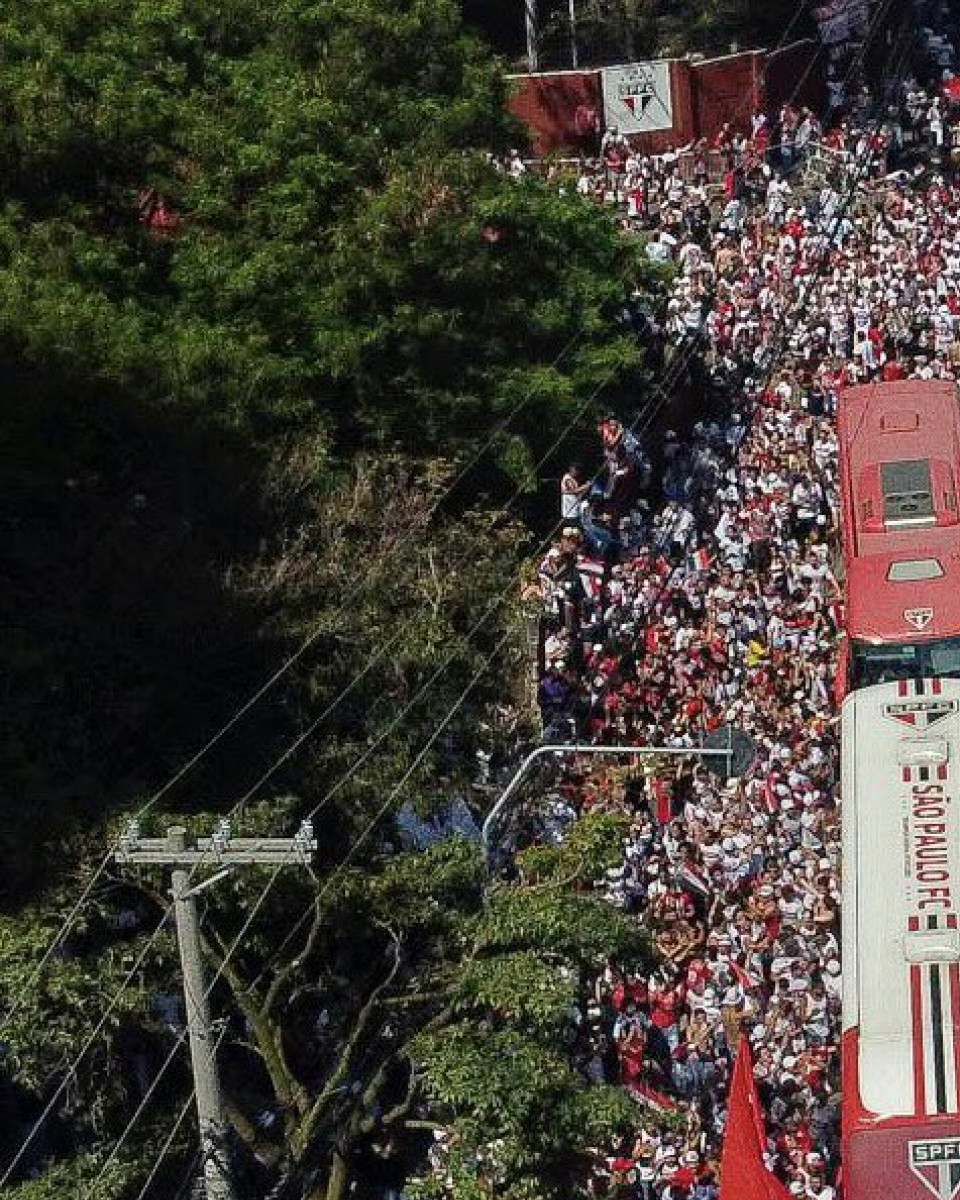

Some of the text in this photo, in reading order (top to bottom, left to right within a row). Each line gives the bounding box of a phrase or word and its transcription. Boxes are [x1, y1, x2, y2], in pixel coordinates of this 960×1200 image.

[911, 784, 951, 909] SÃO PAULO FC
